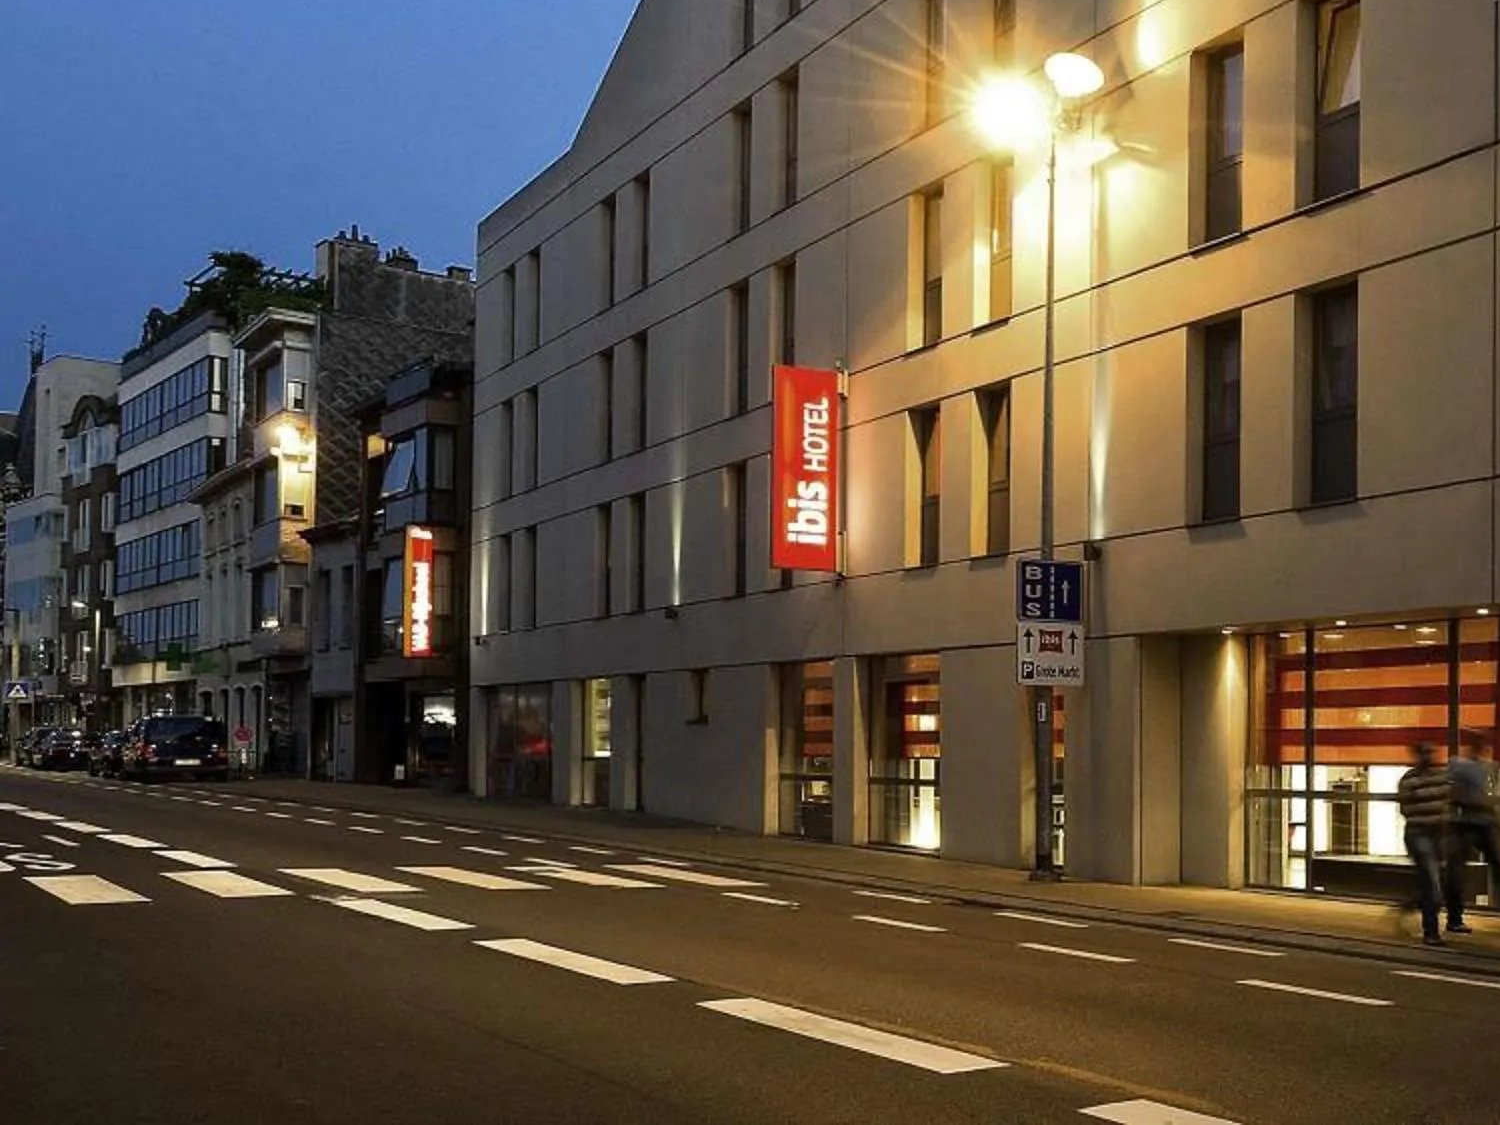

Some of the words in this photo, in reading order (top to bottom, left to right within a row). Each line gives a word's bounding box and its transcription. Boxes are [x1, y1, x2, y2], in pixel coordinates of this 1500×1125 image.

[803, 396, 829, 472] HOTEL
[786, 480, 828, 546] ibis
[1025, 566, 1042, 616] BUS
[1023, 663, 1033, 677] P
